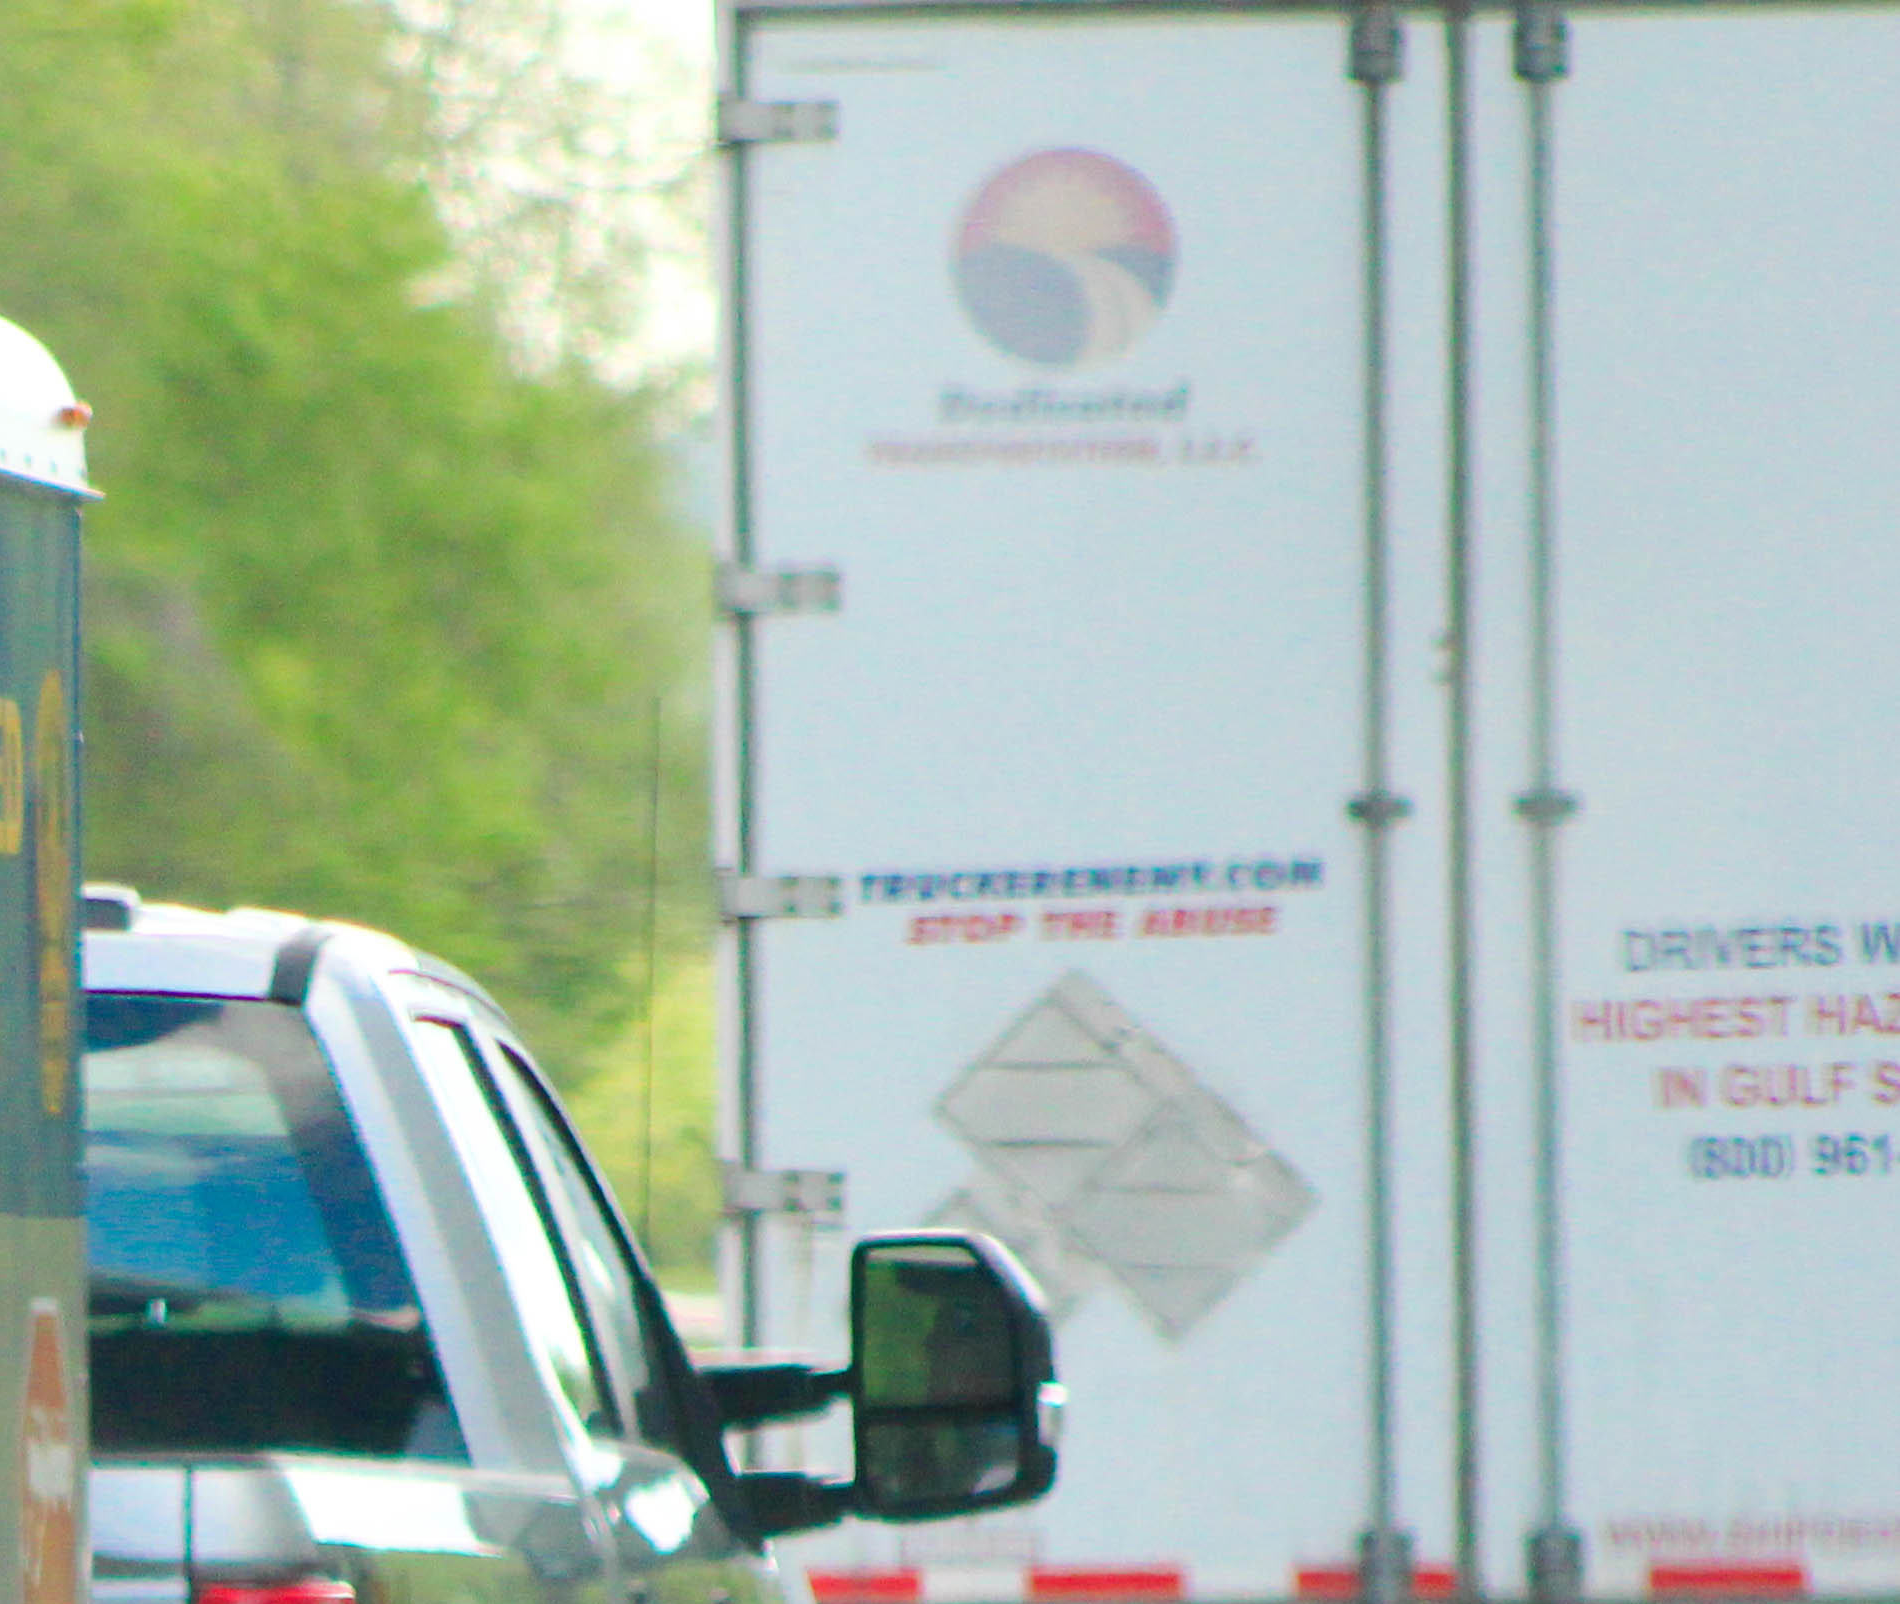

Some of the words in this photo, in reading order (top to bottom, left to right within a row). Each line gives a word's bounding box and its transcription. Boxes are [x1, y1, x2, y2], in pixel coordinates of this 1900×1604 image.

[905, 910, 1023, 945] STOP
[1037, 908, 1120, 940] THE
[1139, 905, 1280, 938] ABUSE
[1619, 922, 1843, 974] DRIVERS
[1573, 996, 1795, 1044] HIGHEST
[1723, 1060, 1859, 1110] GULF
